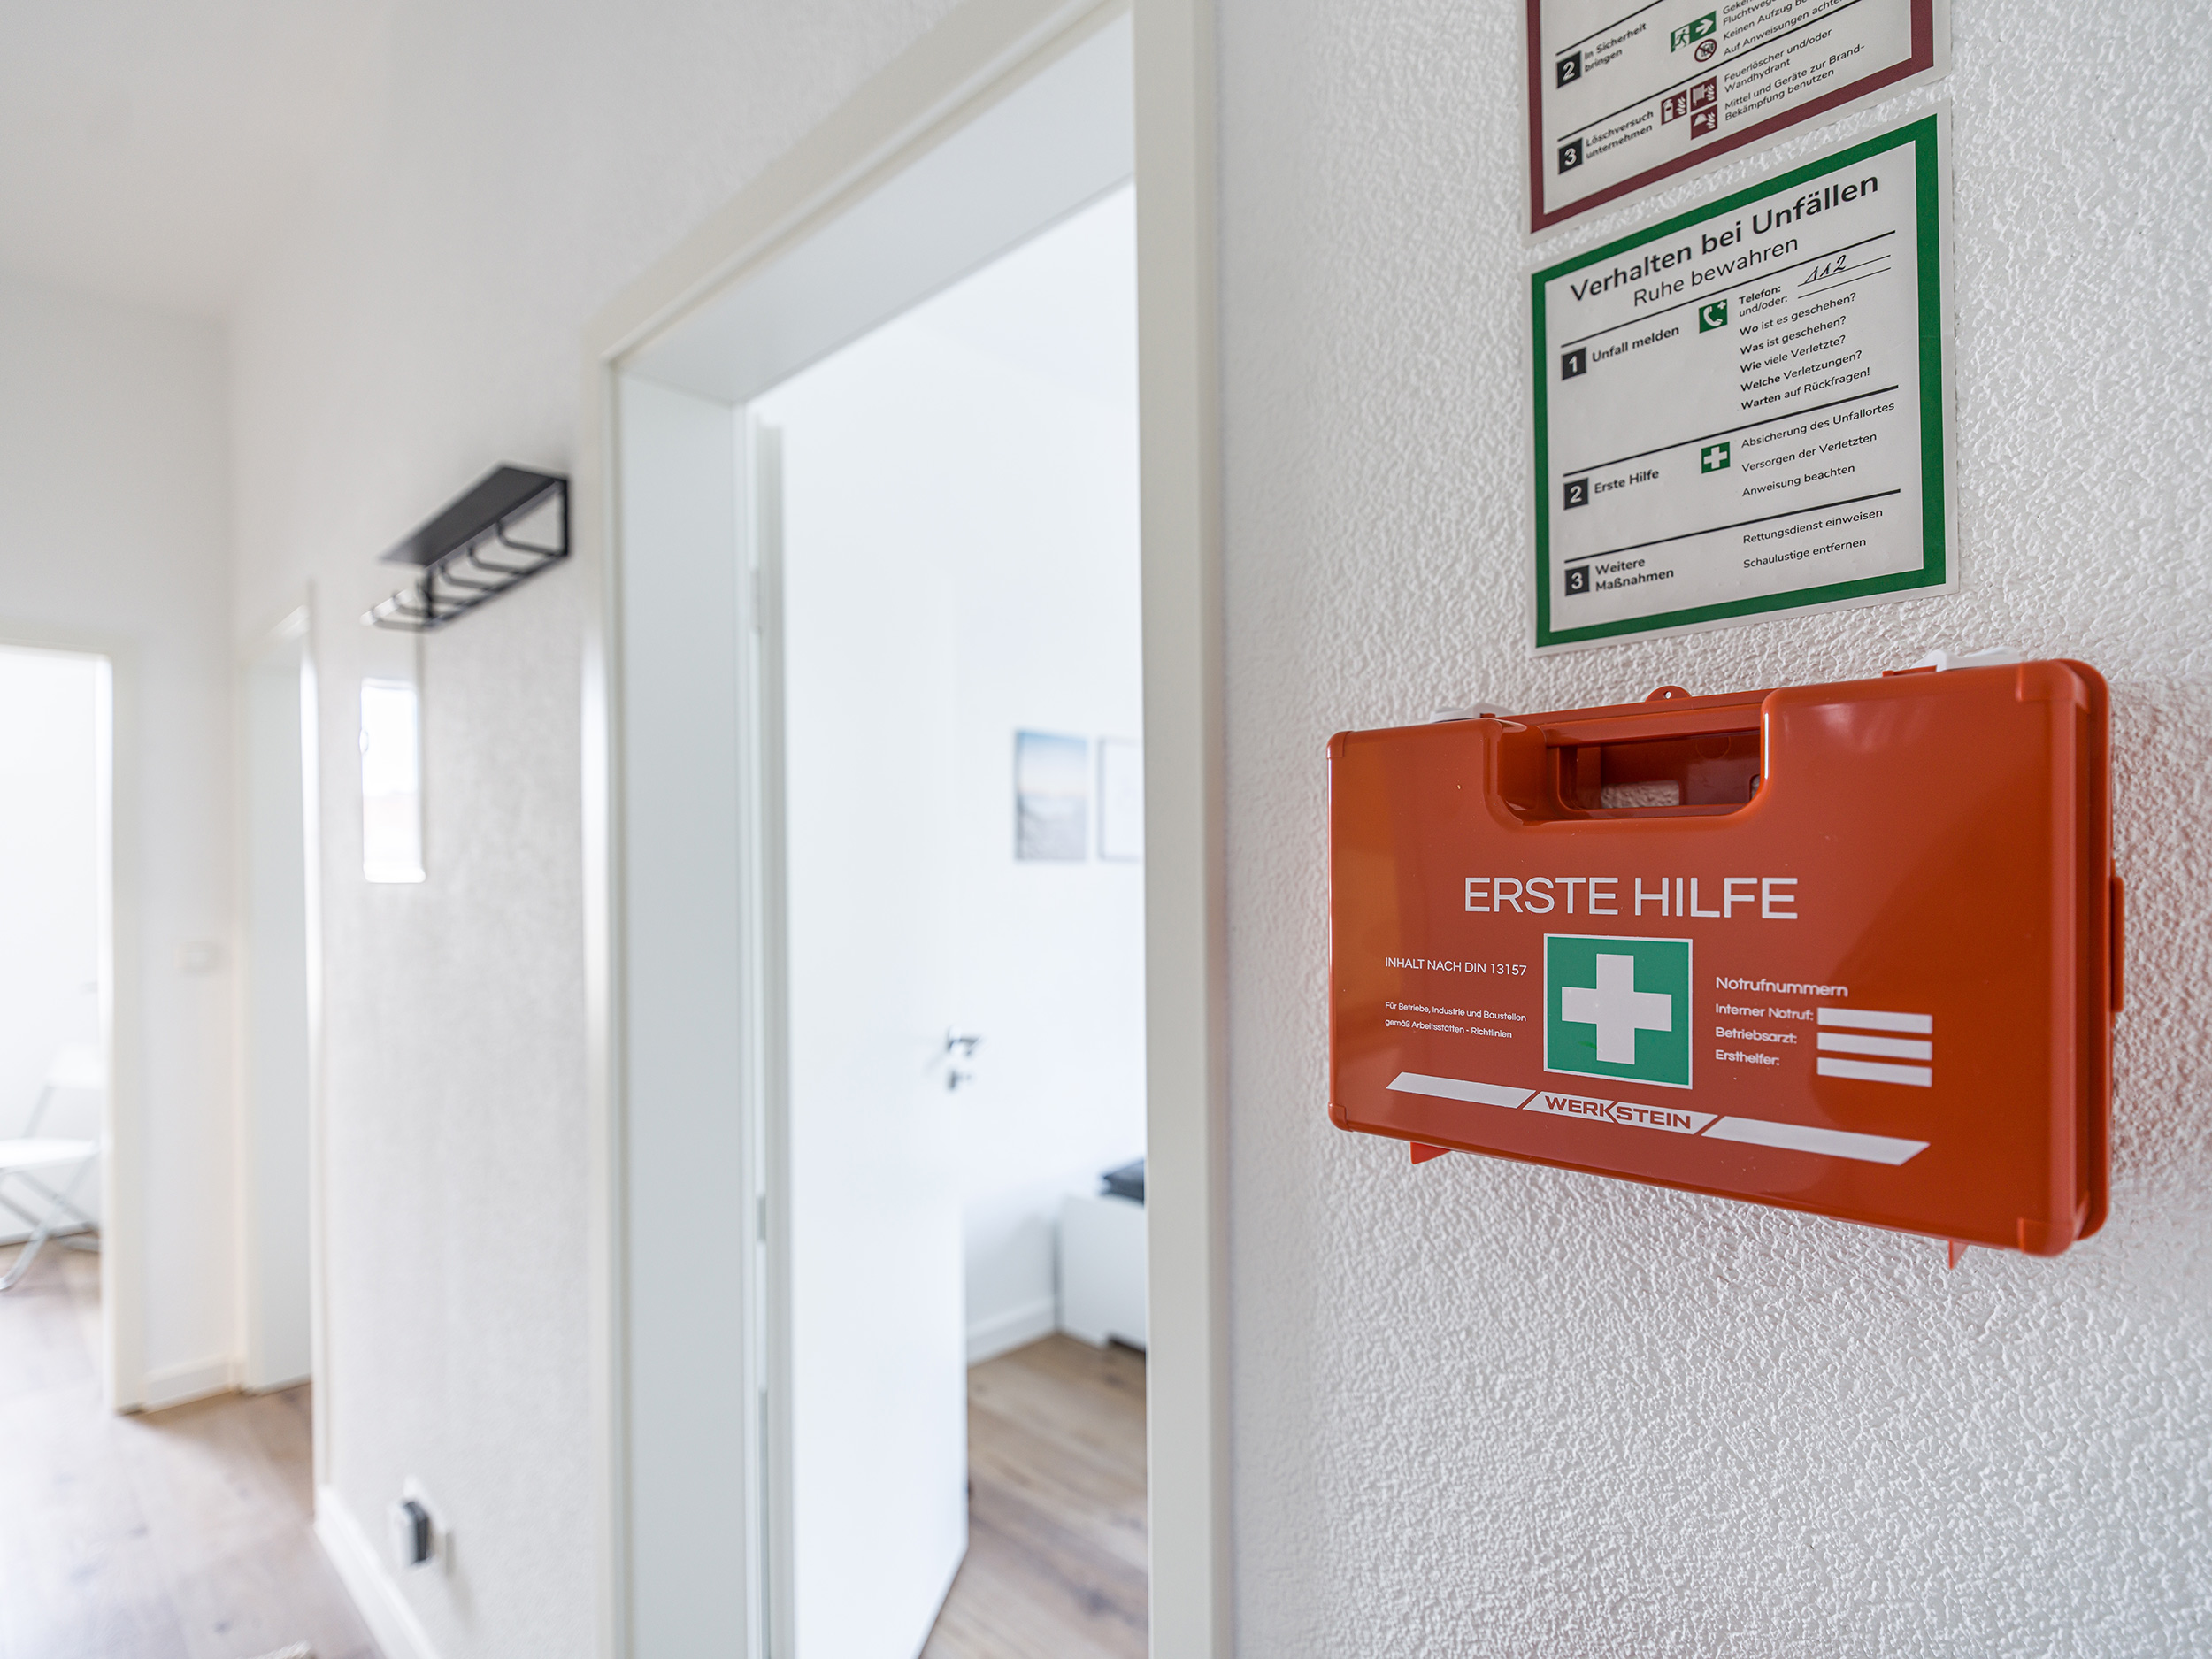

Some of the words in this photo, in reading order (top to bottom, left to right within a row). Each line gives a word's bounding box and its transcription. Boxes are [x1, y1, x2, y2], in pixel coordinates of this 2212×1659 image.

[1723, 0, 1776, 26] Fluchtweg
[1724, 21, 1755, 41] Keinen
[1757, 4, 1793, 25] Aufzug
[1724, 41, 1741, 56] Auf
[1742, 12, 1809, 48] Anweisungen
[1812, 0, 1843, 15] achte
[1585, 50, 1594, 60] In
[1596, 23, 1647, 53] Sicherheit
[1724, 50, 1784, 82] Feuerlöscher
[1786, 28, 1832, 55] und/oder
[1563, 61, 1575, 81] 2
[1585, 49, 1623, 73] bringen
[1724, 58, 1790, 93] Wandhydrant
[1724, 93, 1751, 110] Mittel
[1754, 83, 1771, 97] und
[1774, 71, 1807, 88] Geräte
[1810, 61, 1826, 74] zur
[1829, 44, 1865, 65] Brand-
[1725, 90, 1785, 121] Bekämpfung
[1787, 68, 1834, 94] benutzen
[1586, 111, 1654, 147] Löschversuch
[1586, 125, 1653, 158] unternehmen
[1564, 148, 1577, 166] 3
[1571, 246, 1692, 301] Verhalten
[1701, 220, 1741, 255] bei
[1752, 175, 1878, 234] Unfällen
[1633, 280, 1685, 307] Ruhe
[1692, 238, 1798, 287] bewahren
[1804, 255, 1847, 284] 112
[1739, 286, 1781, 304] Telefon:
[1739, 296, 1788, 317] und/oder:
[1740, 325, 1758, 336] Wo
[1762, 319, 1774, 330] ist
[1777, 317, 1788, 326] es
[1791, 292, 1856, 322] geschehen?
[1569, 356, 1578, 373] 1
[1593, 342, 1628, 362] Unfall
[1632, 325, 1679, 349] melden
[1740, 343, 1763, 355] Was
[1767, 337, 1779, 348] ist
[1782, 315, 1847, 344] geschehen?
[1740, 361, 1762, 373] Wie
[1764, 353, 1788, 366] viele
[1791, 334, 1846, 358] Verletzte?
[1740, 375, 1780, 392] Welche
[1783, 349, 1863, 380] Verletzungen?
[1741, 395, 1780, 410] Warten
[1784, 387, 1801, 398] auf
[1804, 367, 1870, 394] Rückfragen!
[1741, 425, 1807, 449] Absicherung
[1810, 419, 1830, 431] des
[1833, 403, 1895, 425] Unfallortes
[1741, 453, 1795, 472] Versorgen
[1799, 448, 1816, 459] der
[1819, 433, 1877, 453] Verletzten
[1570, 485, 1582, 503] 2
[1594, 479, 1625, 494] Erste
[1629, 469, 1659, 485] Hilfe
[1742, 477, 1801, 496] Anweisung
[1804, 465, 1855, 483] beachten
[1743, 520, 1823, 543] Rettungsdienst
[1825, 510, 1883, 527] einweisen
[1595, 557, 1646, 575] Weitere
[1743, 549, 1809, 568] Schaulustige
[1813, 538, 1866, 556] entfernen
[1571, 572, 1583, 590] 3
[1595, 569, 1674, 592] Maßnahmen
[1465, 877, 1618, 915] ERSTE
[1634, 877, 1798, 920] HILFE
[1385, 957, 1425, 970] INHALT
[1427, 960, 1462, 972] NACH
[1464, 962, 1486, 973] DIN
[1490, 964, 1527, 976] 13157
[1716, 976, 1848, 997] Notrufnummern
[1398, 1002, 1431, 1014] Betriebe,
[1432, 1006, 1465, 1017] Industrie
[1466, 1010, 1482, 1018] und
[1483, 1011, 1526, 1022] Baustellen
[1716, 1003, 1765, 1017] Interner
[1768, 1007, 1814, 1021] Notruf:
[1385, 1019, 1410, 1028] gemäß
[1411, 1021, 1464, 1033] Arbeitsstätten
[1471, 1027, 1512, 1039] Richtlinien
[1715, 1026, 1797, 1044] Betriebsarzt:
[1715, 1049, 1780, 1066] Ersthelfer:
[1545, 1095, 1691, 1129] WERKSTEIN
